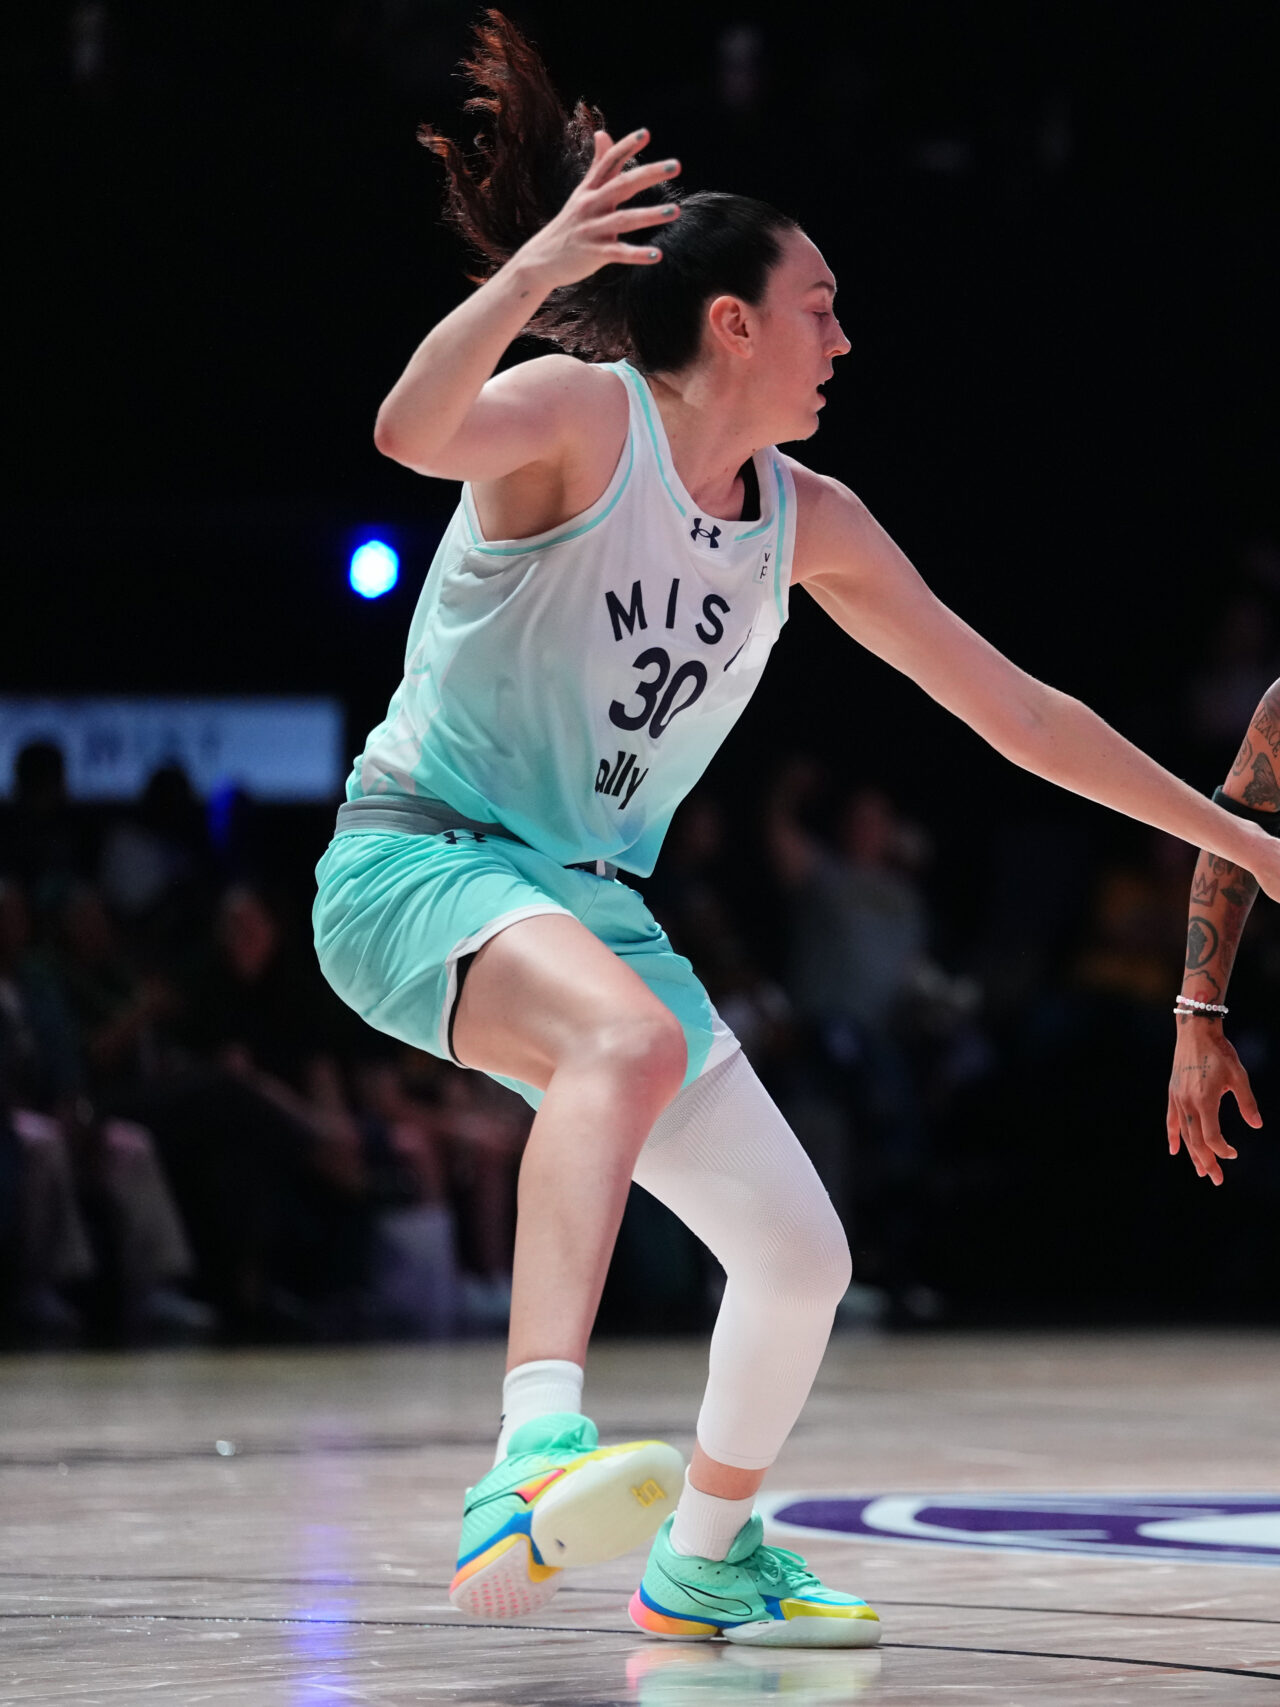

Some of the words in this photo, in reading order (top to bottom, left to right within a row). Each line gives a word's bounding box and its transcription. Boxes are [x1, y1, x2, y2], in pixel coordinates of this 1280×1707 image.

[605, 578, 752, 672] MIS
[609, 647, 708, 739] 30
[594, 751, 649, 810] ally
